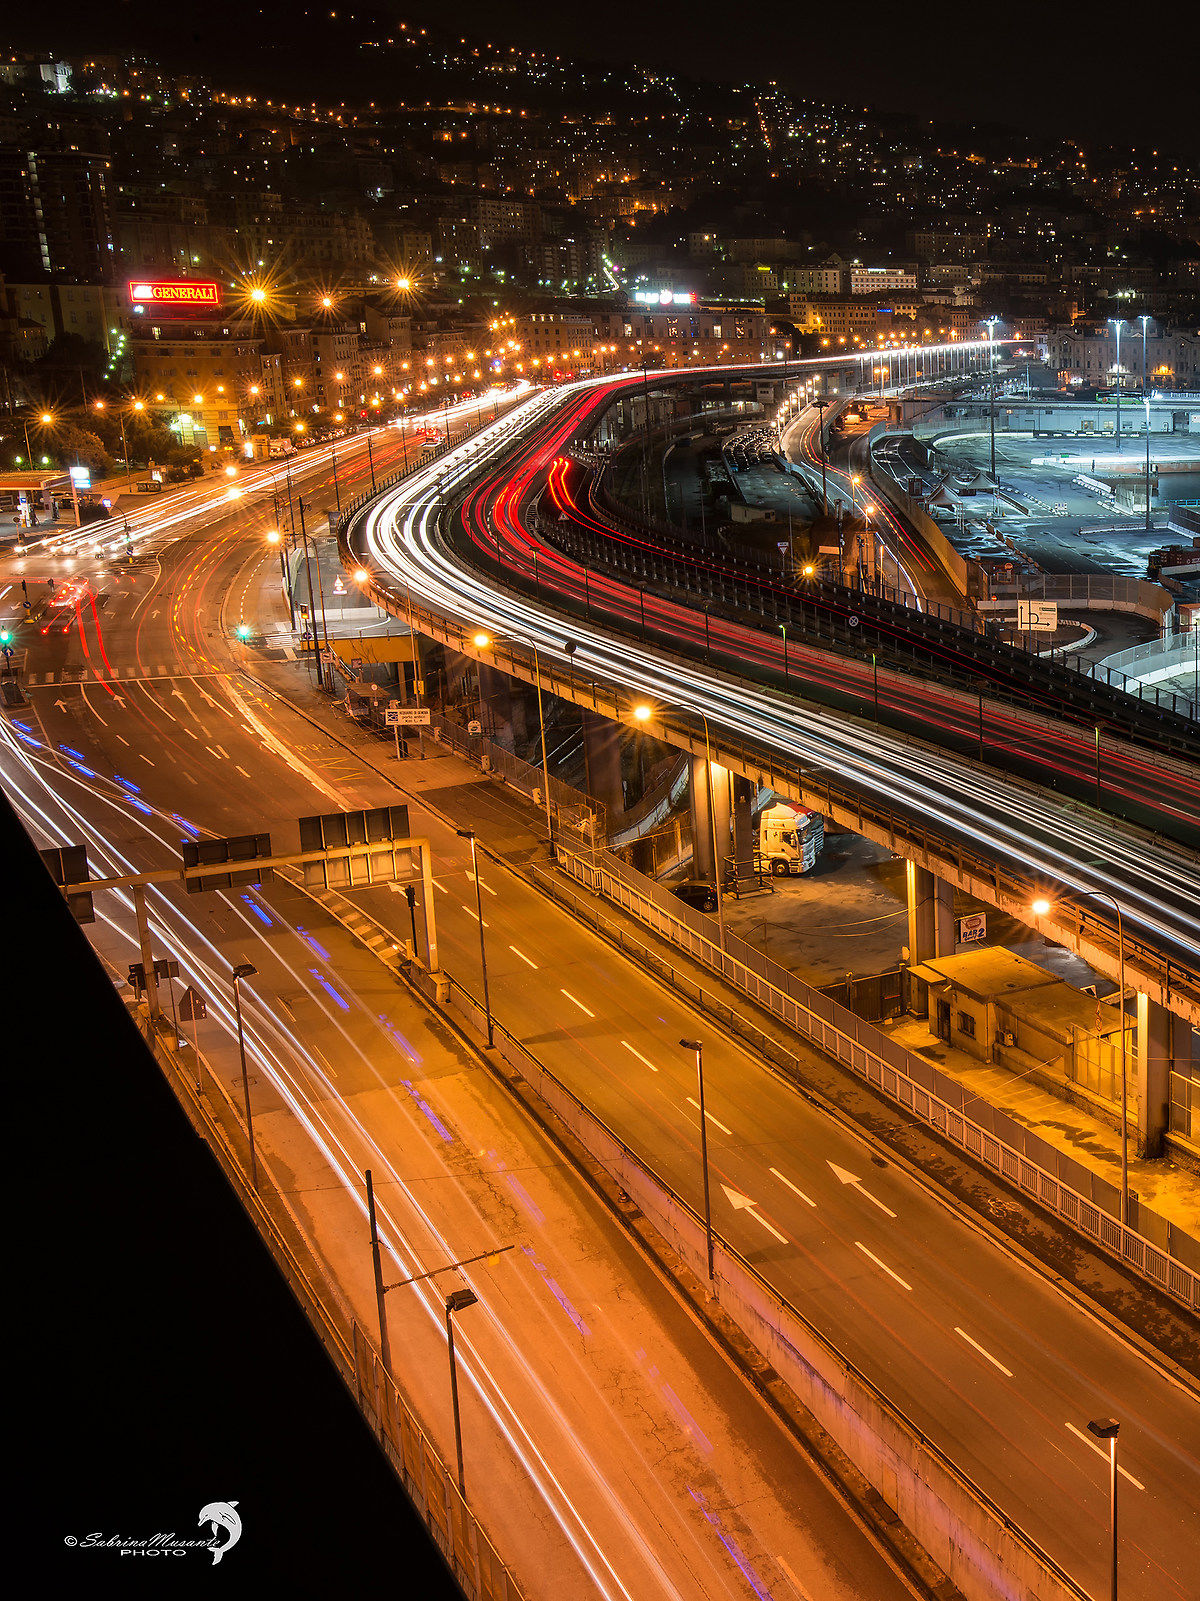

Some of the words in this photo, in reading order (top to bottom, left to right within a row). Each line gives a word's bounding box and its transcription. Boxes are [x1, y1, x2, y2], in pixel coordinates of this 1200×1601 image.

[153, 287, 214, 299] GENERALI
[963, 929, 978, 939] BAR
[978, 928, 985, 937] 2
